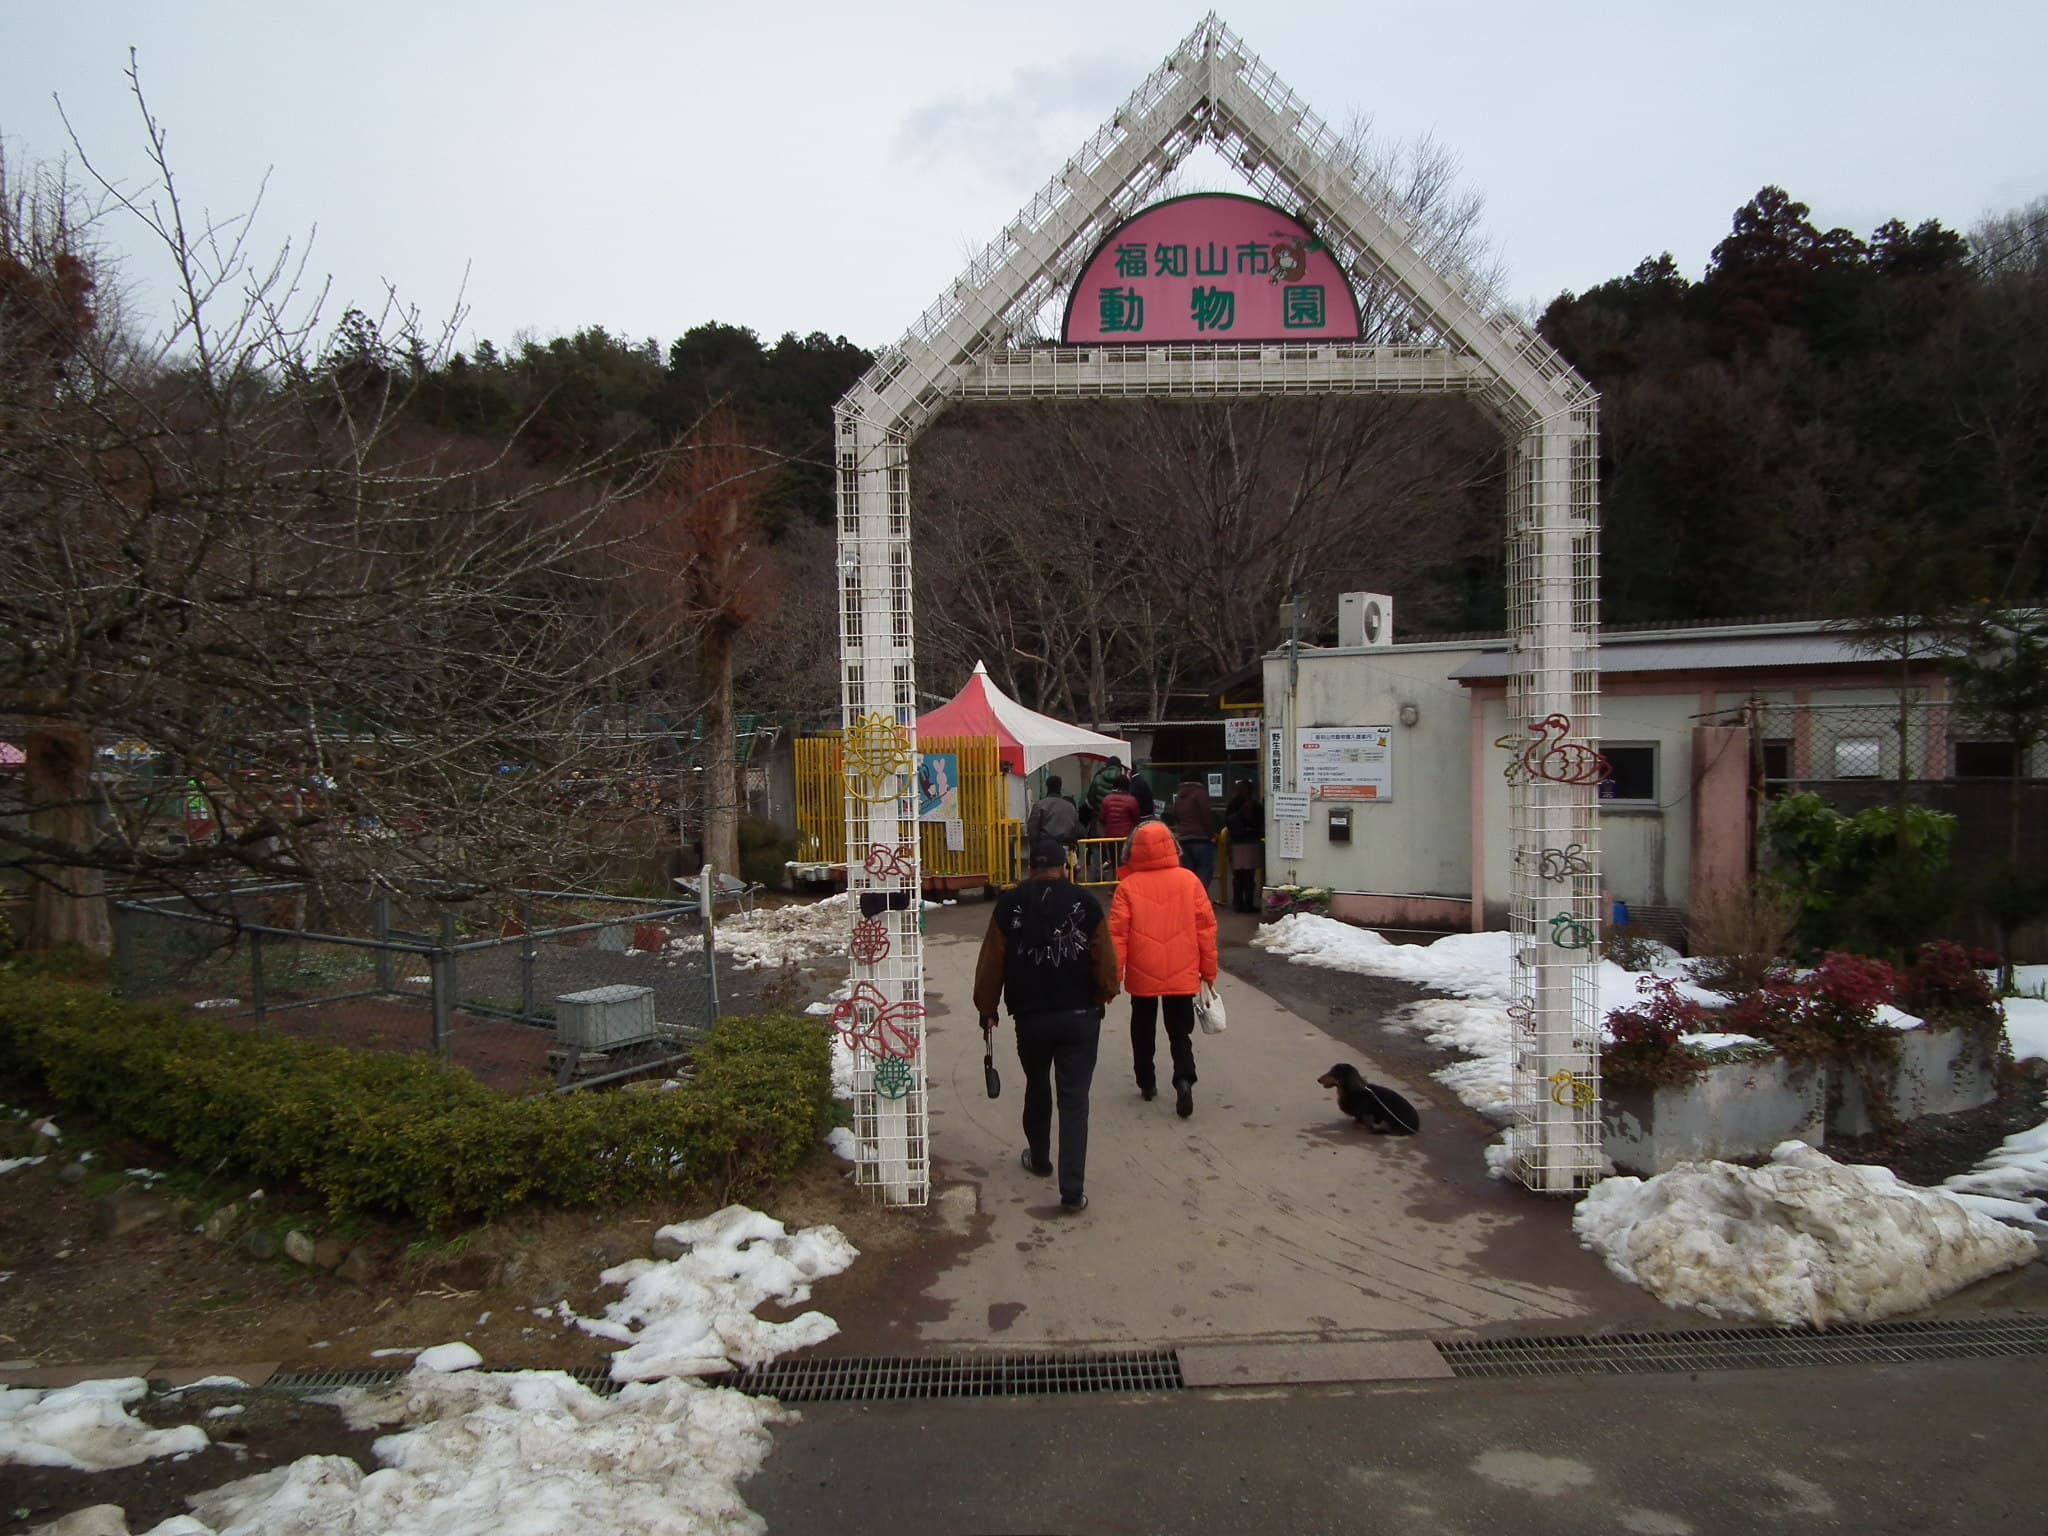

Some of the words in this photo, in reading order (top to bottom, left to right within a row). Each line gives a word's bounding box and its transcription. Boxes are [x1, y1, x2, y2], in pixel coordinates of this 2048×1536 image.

[1114, 241, 1270, 279] 福知山市
[1098, 285, 1326, 332] 動物園
